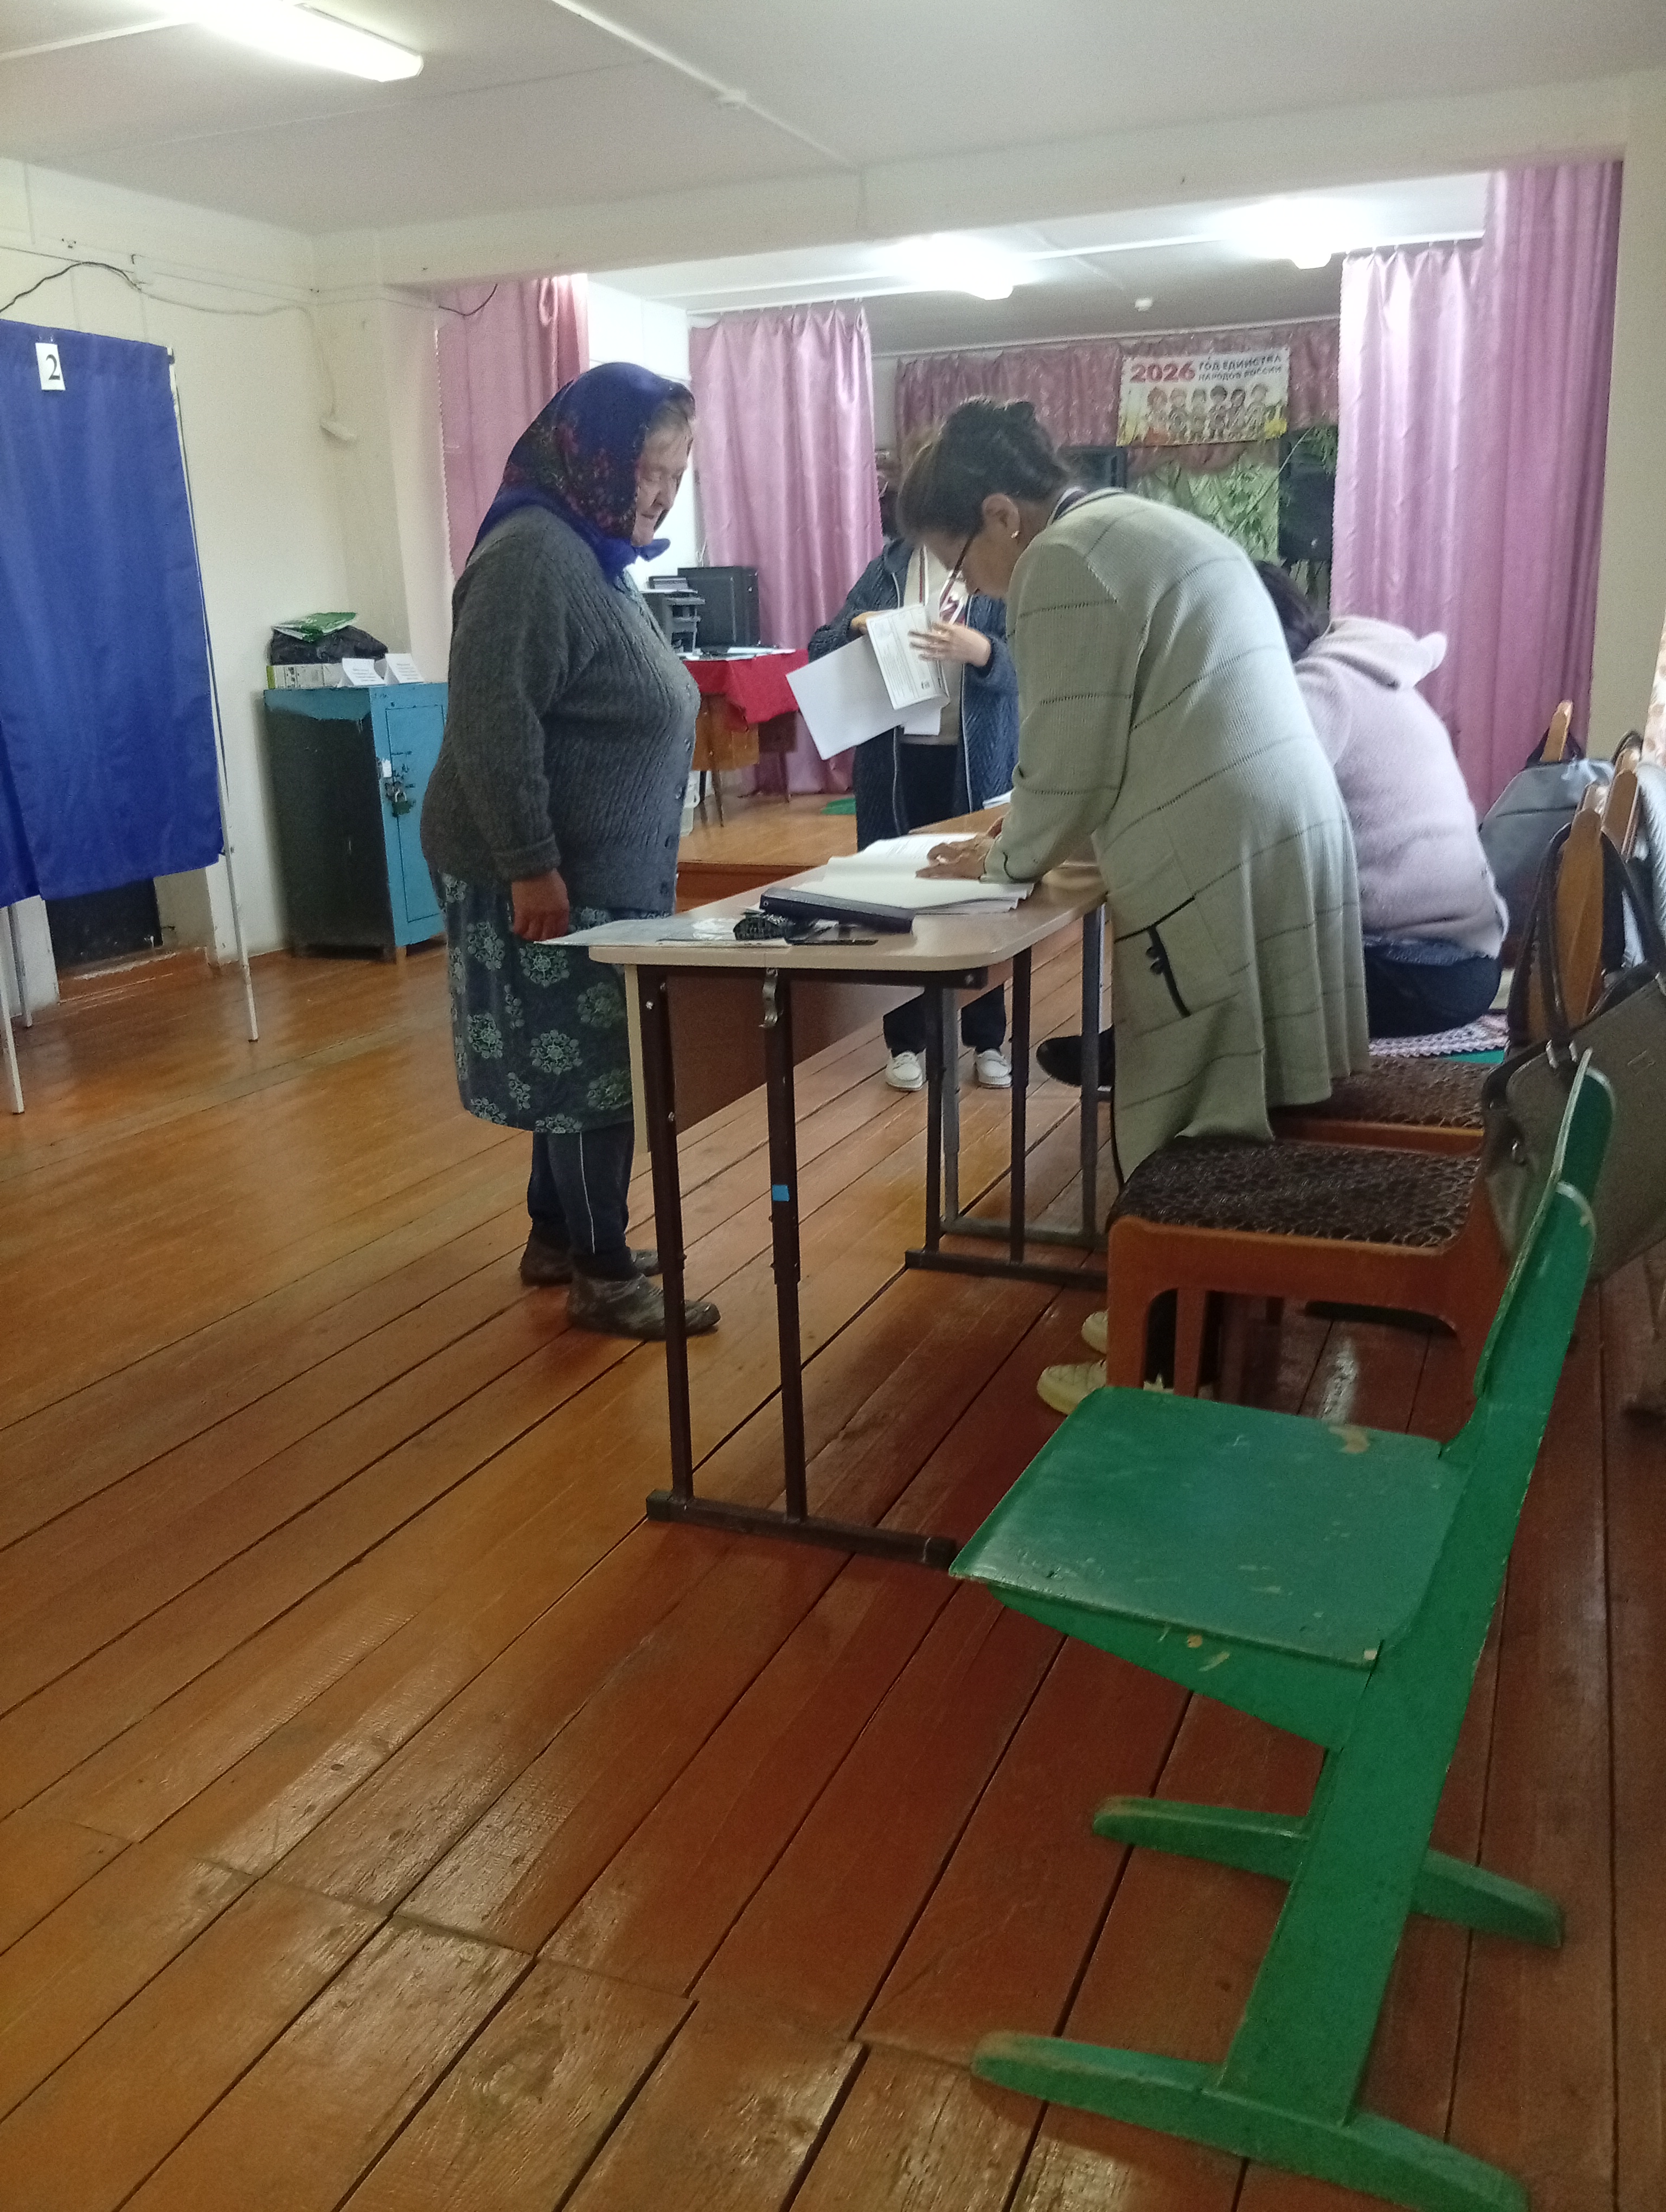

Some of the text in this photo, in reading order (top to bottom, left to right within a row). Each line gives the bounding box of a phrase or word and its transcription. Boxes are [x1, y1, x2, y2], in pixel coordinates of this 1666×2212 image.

[46, 354, 61, 380] 2
[1130, 361, 1195, 382] 2026
[1198, 360, 1219, 371] ГОД
